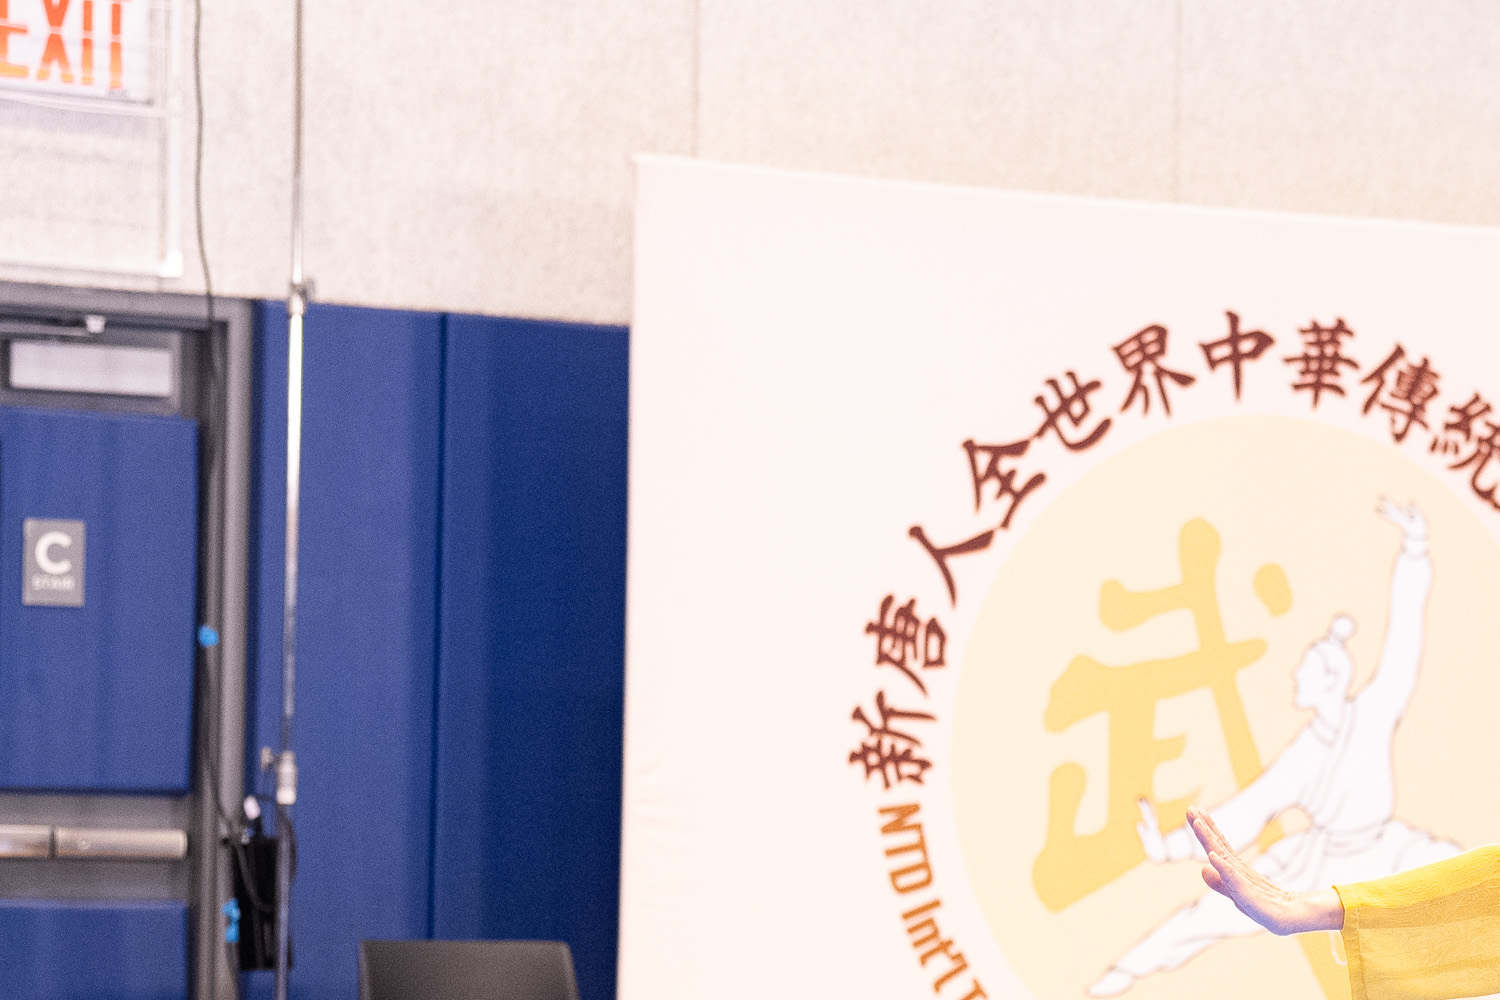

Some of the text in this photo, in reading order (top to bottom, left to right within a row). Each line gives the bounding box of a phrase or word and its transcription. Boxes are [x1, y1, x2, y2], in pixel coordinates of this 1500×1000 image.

[35, 531, 72, 575] C
[878, 803, 935, 895] NTD
[901, 899, 969, 994] Int'l
